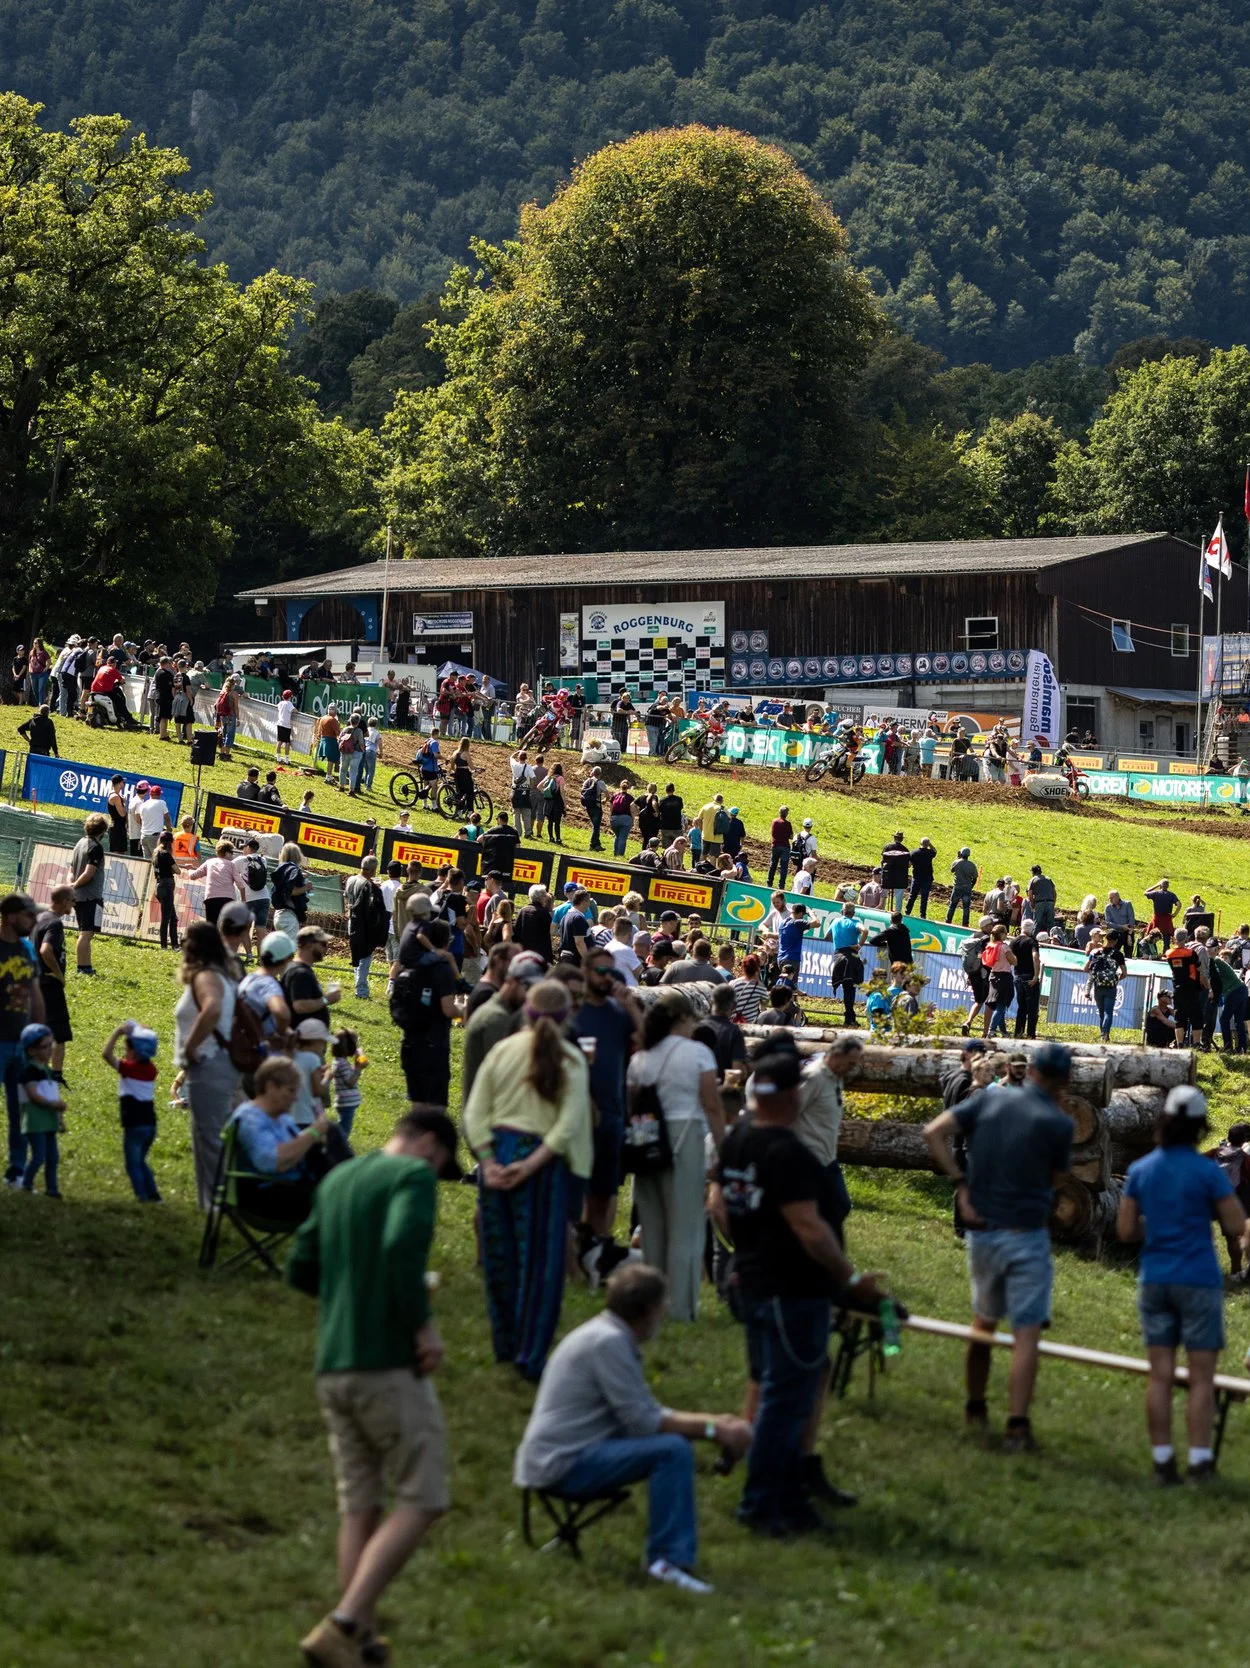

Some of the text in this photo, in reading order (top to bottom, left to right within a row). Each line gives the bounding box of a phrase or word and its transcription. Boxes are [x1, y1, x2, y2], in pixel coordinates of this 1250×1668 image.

[613, 615, 694, 634] ROGGENBURG
[832, 705, 861, 713] BUCHER
[80, 774, 136, 800] YAMH
[1151, 779, 1212, 798] MOTOREX
[304, 827, 358, 852] PIRELLI
[654, 883, 707, 905] PIRELLI
